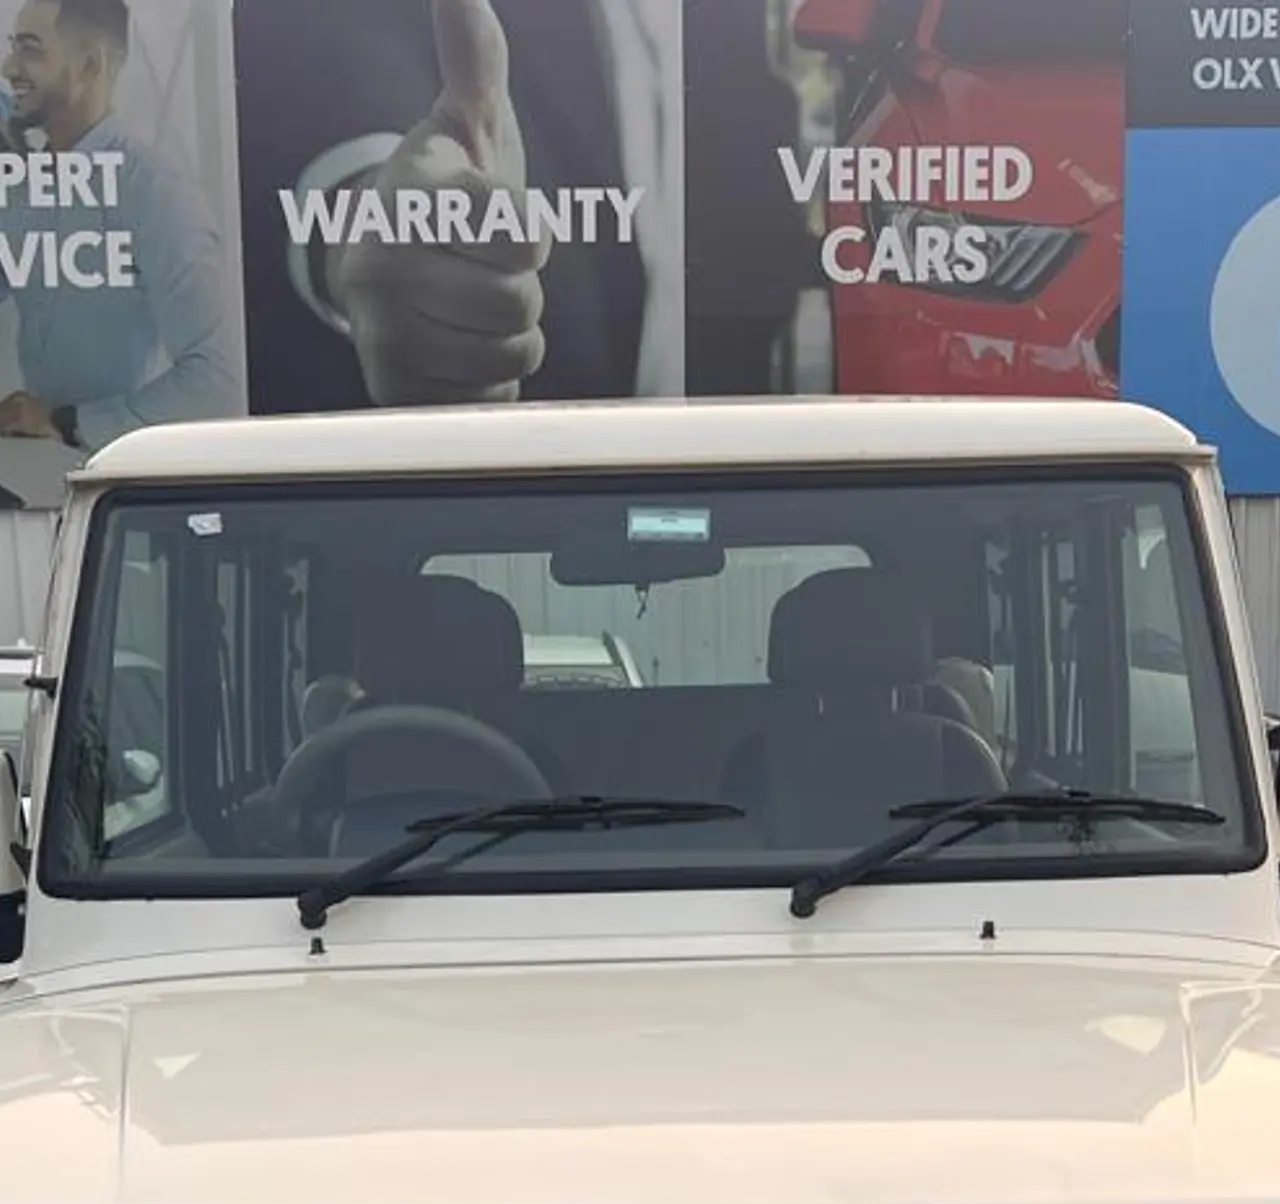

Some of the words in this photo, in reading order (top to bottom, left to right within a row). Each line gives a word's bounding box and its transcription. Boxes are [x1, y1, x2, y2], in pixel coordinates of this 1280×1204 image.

[1191, 8, 1278, 39] WIDE
[1193, 57, 1264, 89] OLX
[777, 145, 1034, 202] VERIFIED
[278, 187, 646, 243] WARRANTY
[821, 225, 988, 284] CARS
